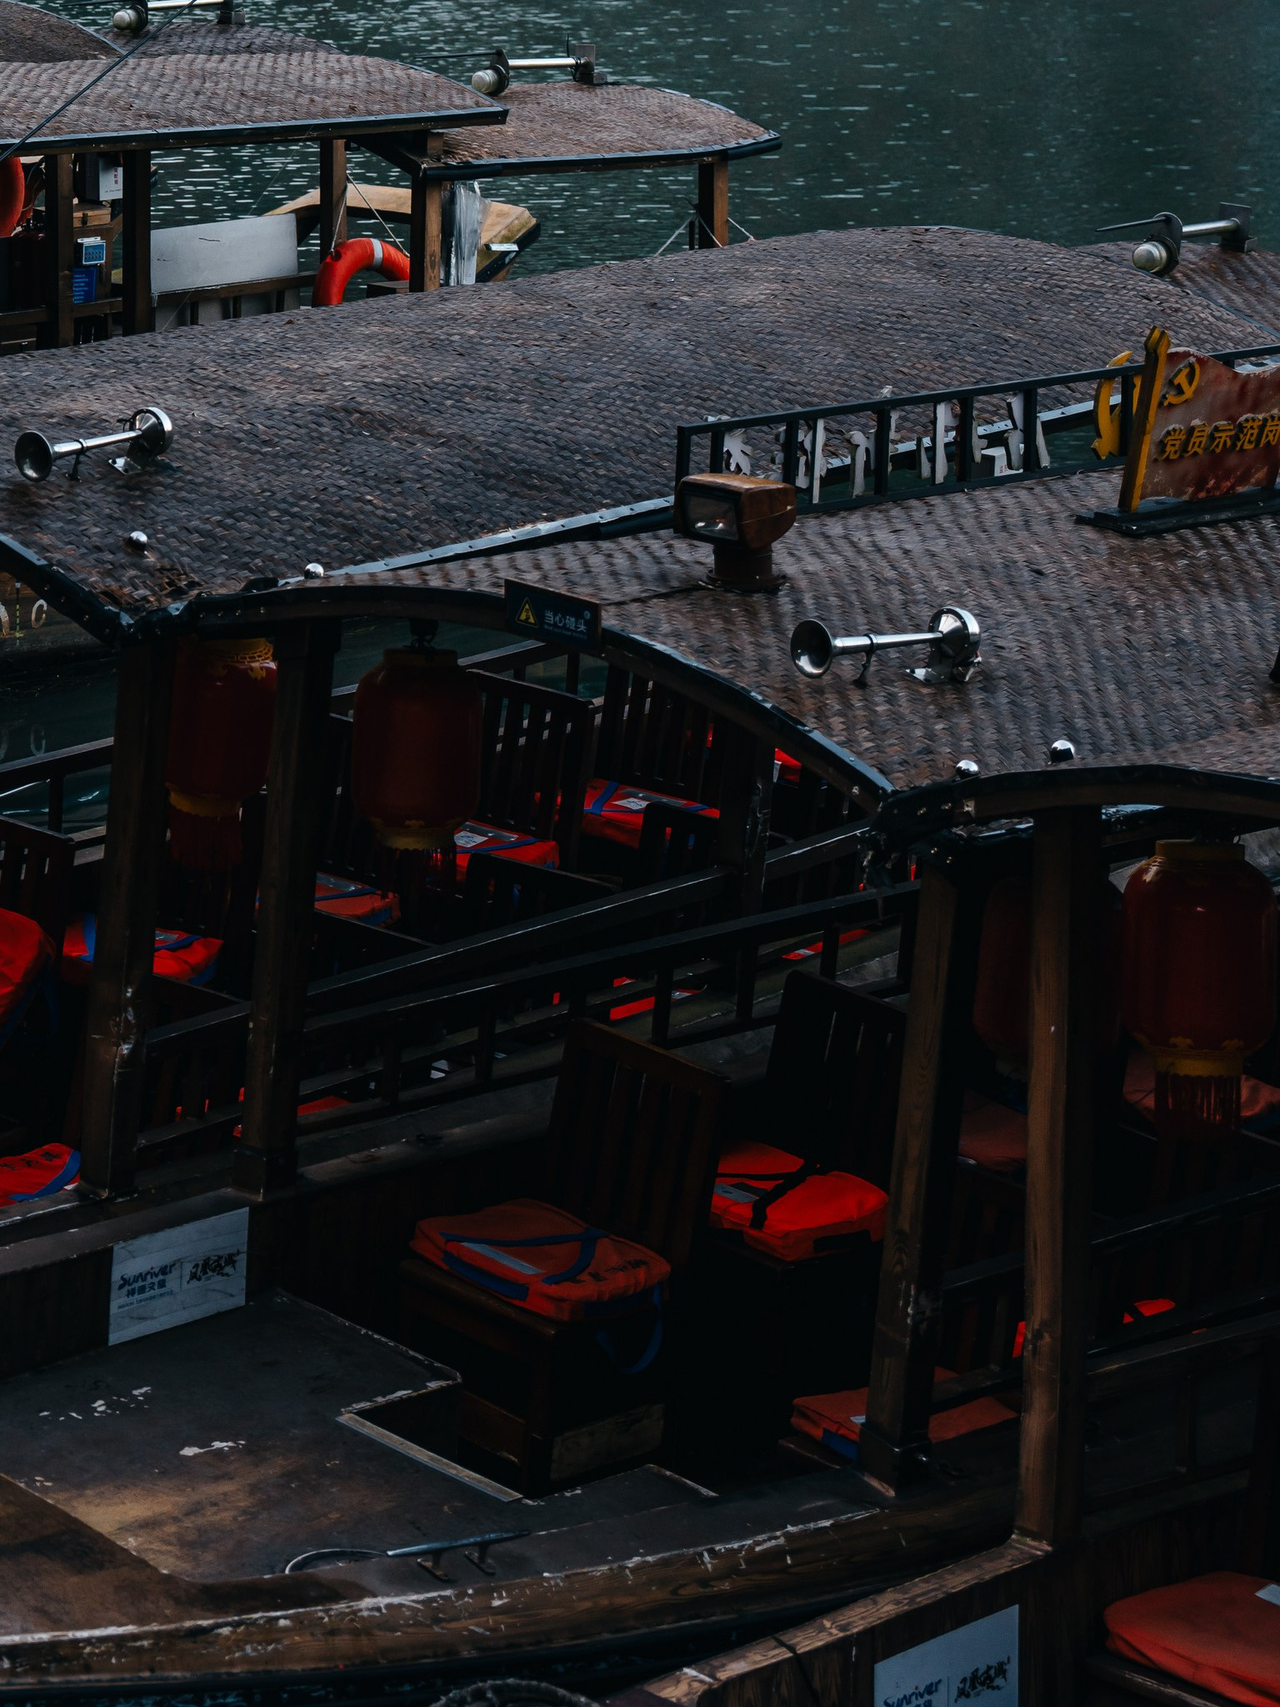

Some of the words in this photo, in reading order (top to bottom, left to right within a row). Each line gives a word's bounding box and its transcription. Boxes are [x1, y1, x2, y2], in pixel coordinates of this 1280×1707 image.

[1159, 415, 1280, 461] 党员示范岗
[544, 609, 587, 632] 当心碰头
[118, 1263, 176, 1291] Sunriver
